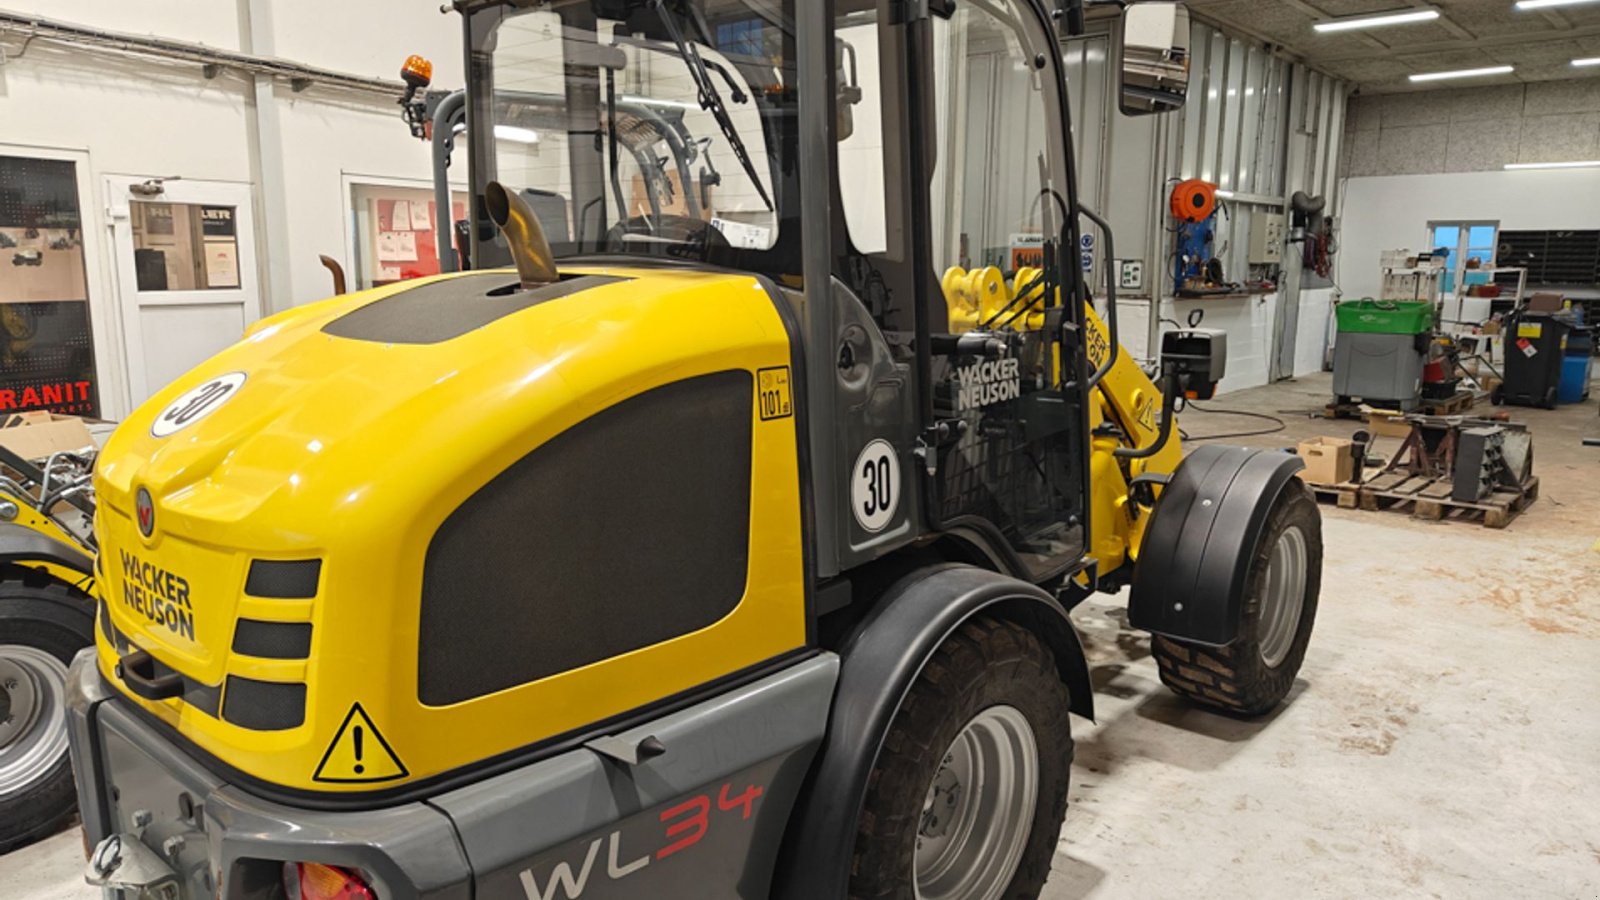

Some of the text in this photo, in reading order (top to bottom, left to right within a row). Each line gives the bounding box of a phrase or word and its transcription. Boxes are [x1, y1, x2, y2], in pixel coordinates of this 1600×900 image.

[1086, 317, 1106, 356] CKER
[957, 357, 1020, 388] WACKER
[0, 380, 90, 410] RANIT
[163, 380, 234, 425] 30
[762, 389, 781, 416] 101
[958, 378, 1020, 411] NEUSON
[863, 455, 891, 516] 30
[119, 547, 193, 610] WACKER
[123, 578, 195, 642] NEUSON
